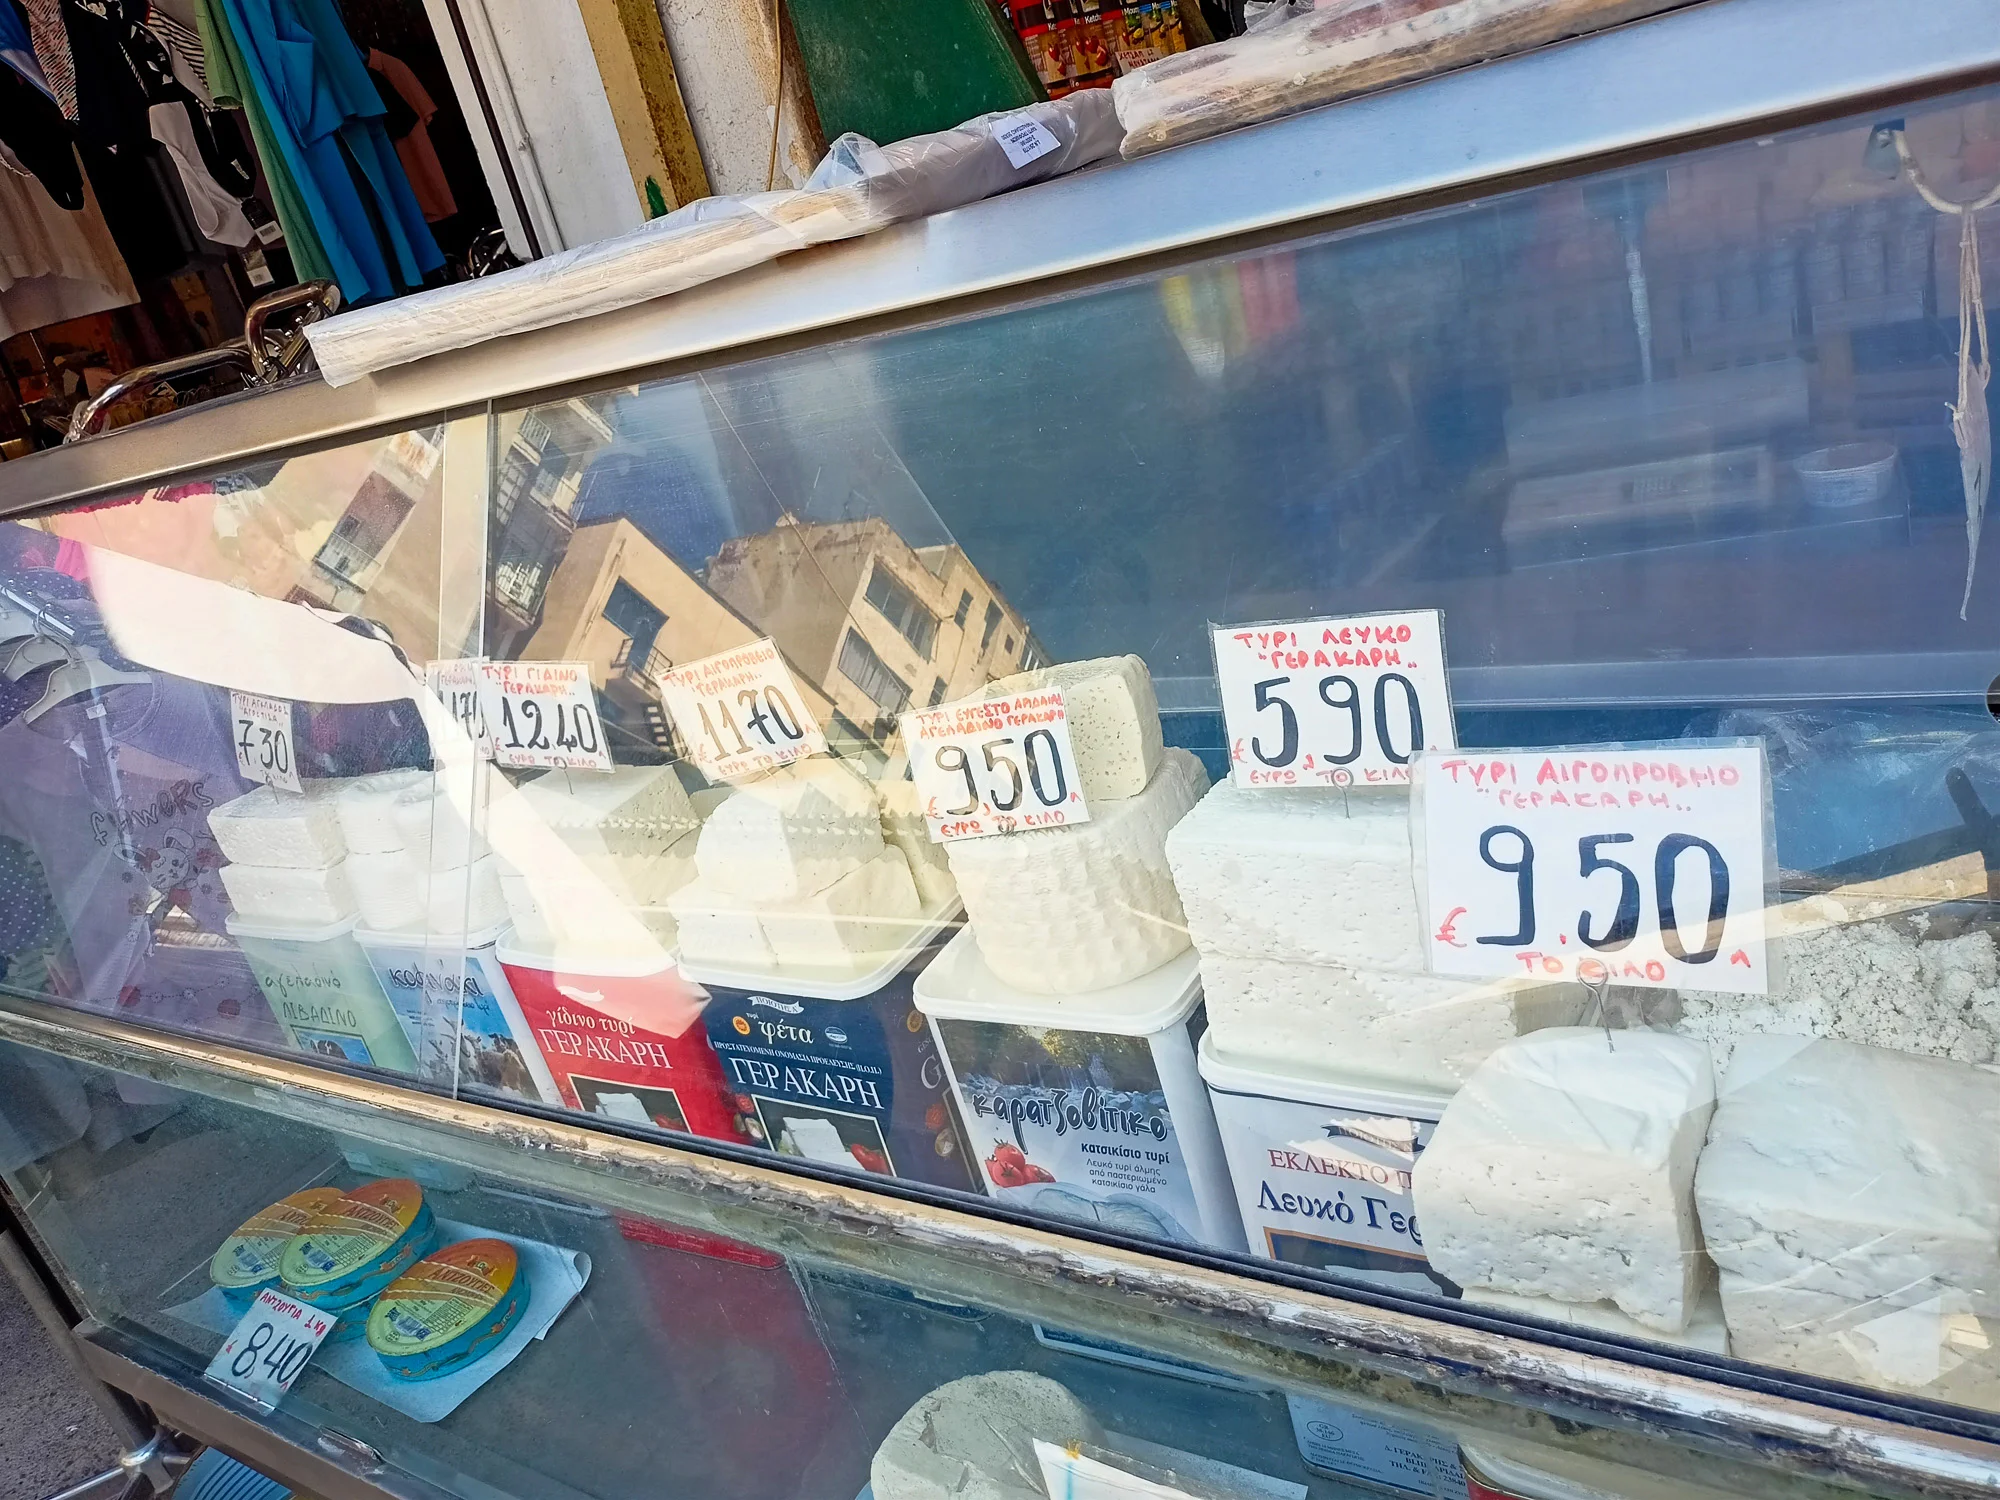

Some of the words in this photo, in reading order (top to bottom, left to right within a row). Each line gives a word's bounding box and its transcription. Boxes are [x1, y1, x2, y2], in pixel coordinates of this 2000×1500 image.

[1233, 631, 1297, 649] ΤΥΡΙ
[1322, 624, 1411, 645] ΛΕΥΚΟ
[482, 666, 519, 680] ΤΥΡΙ
[526, 668, 578, 682] ΓΙΔΙΝΟ
[915, 711, 950, 726] ΤΥΡΙ
[1316, 769, 1348, 784] ΤΟ
[1440, 759, 1517, 786] ΤΥΡΙ
[1515, 951, 1563, 973] ΤΟ
[282, 1001, 357, 1028] ΛΙΒΑΔΙΝΟ
[545, 1008, 596, 1031] γίδινο
[598, 1016, 636, 1036] τυρί
[757, 1017, 814, 1045] φέτα
[538, 1028, 674, 1070] ΓΕΡΑΚΑΡΗ
[728, 1057, 886, 1111] ΓΕΡΑΚΑΡΗ
[971, 1086, 1168, 1155] καρατζοβίτικο
[1081, 1142, 1142, 1160] κατσικίσιο
[1144, 1151, 1170, 1165] τυρί
[1086, 1158, 1113, 1169] Λευκό
[1115, 1163, 1132, 1172] τυρί
[1134, 1164, 1160, 1176] άλμης
[1089, 1169, 1105, 1177] από
[1107, 1171, 1167, 1186] παστεριωμένο
[1267, 1149, 1389, 1185] ΕΚΛΕΚΤΟ
[1091, 1178, 1133, 1190] κατσικίσιο
[1135, 1184, 1156, 1193] γάλα
[1257, 1180, 1355, 1225] Λευκό
